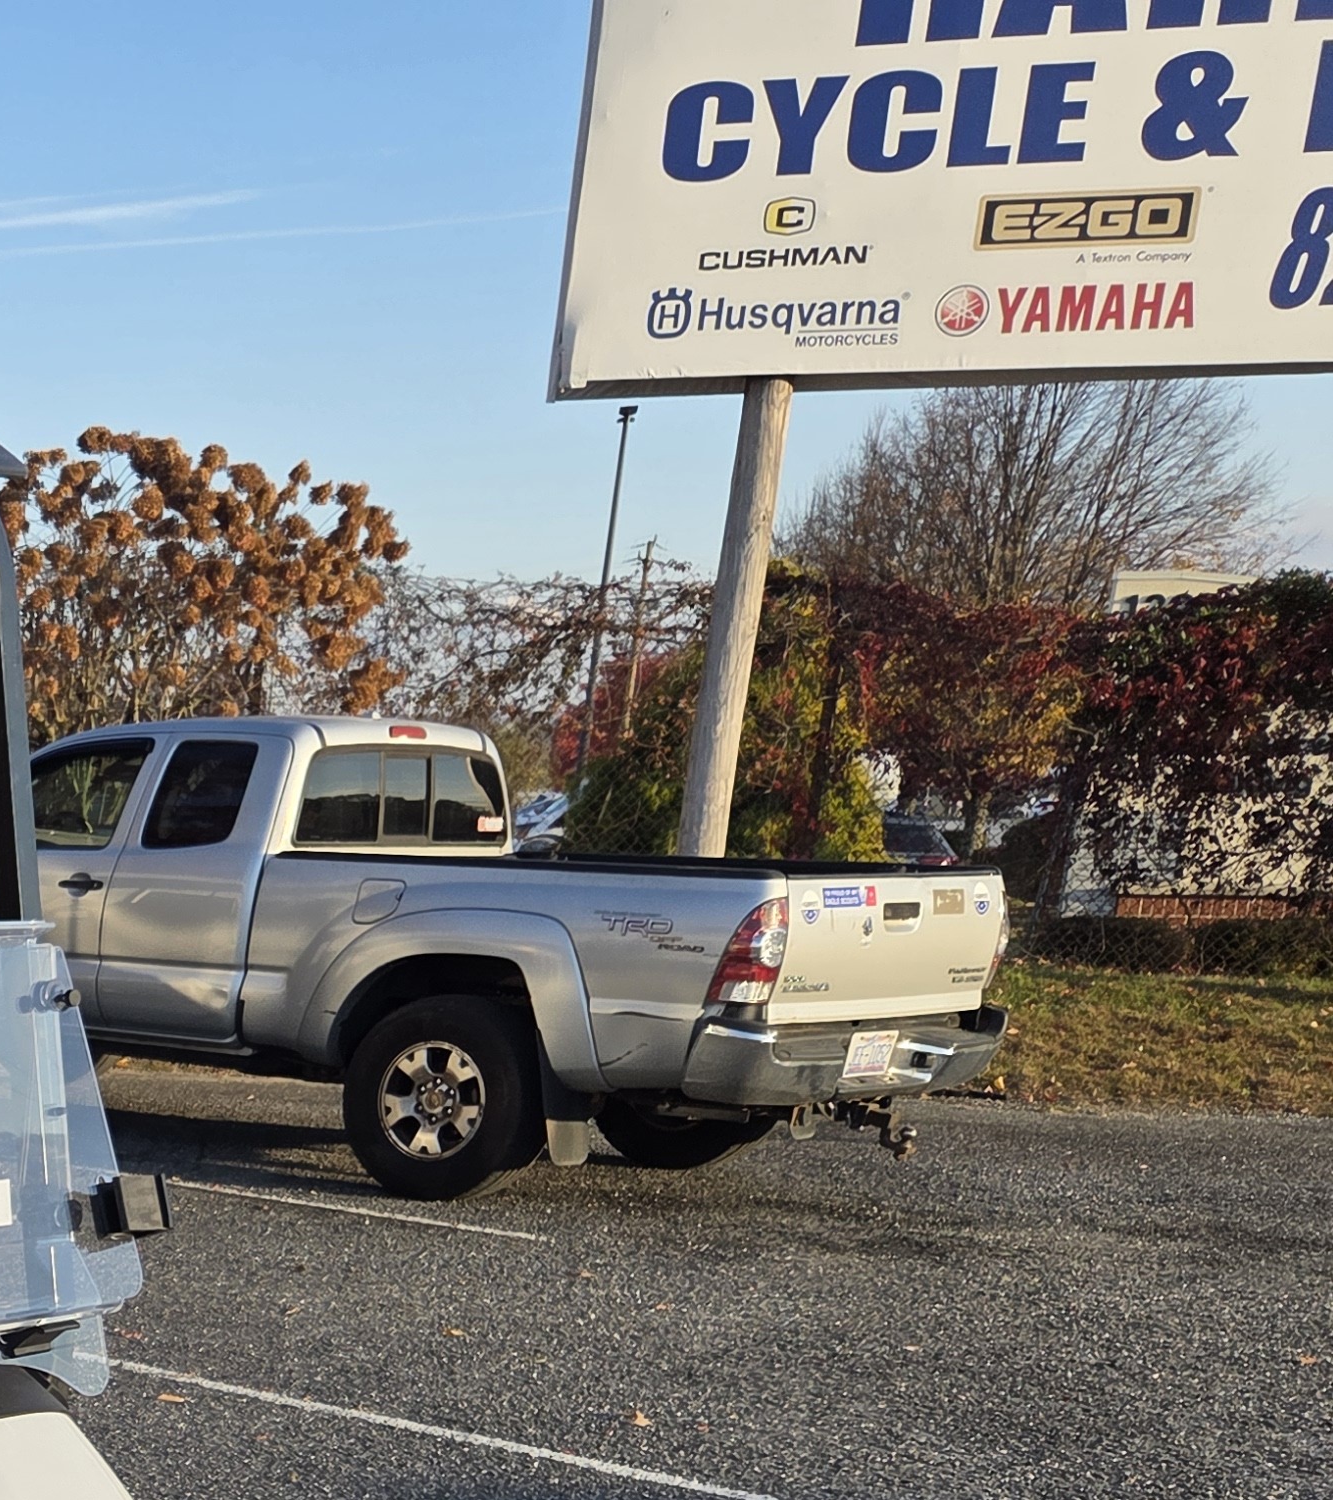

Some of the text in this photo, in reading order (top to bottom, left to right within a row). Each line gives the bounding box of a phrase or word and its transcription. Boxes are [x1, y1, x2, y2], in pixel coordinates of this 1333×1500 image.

[662, 61, 1096, 183] CYCLE
[1141, 50, 1250, 161] &
[990, 198, 1183, 242] EZGO
[698, 246, 870, 272] CUSHMAN
[1075, 250, 1193, 265] A Textron Company
[697, 296, 901, 335] Husqvarna
[997, 281, 1194, 334] YAMAHA
[795, 332, 899, 348] MOTORCYCLES
[601, 914, 674, 938] TRD
[657, 943, 705, 953] ROAD
